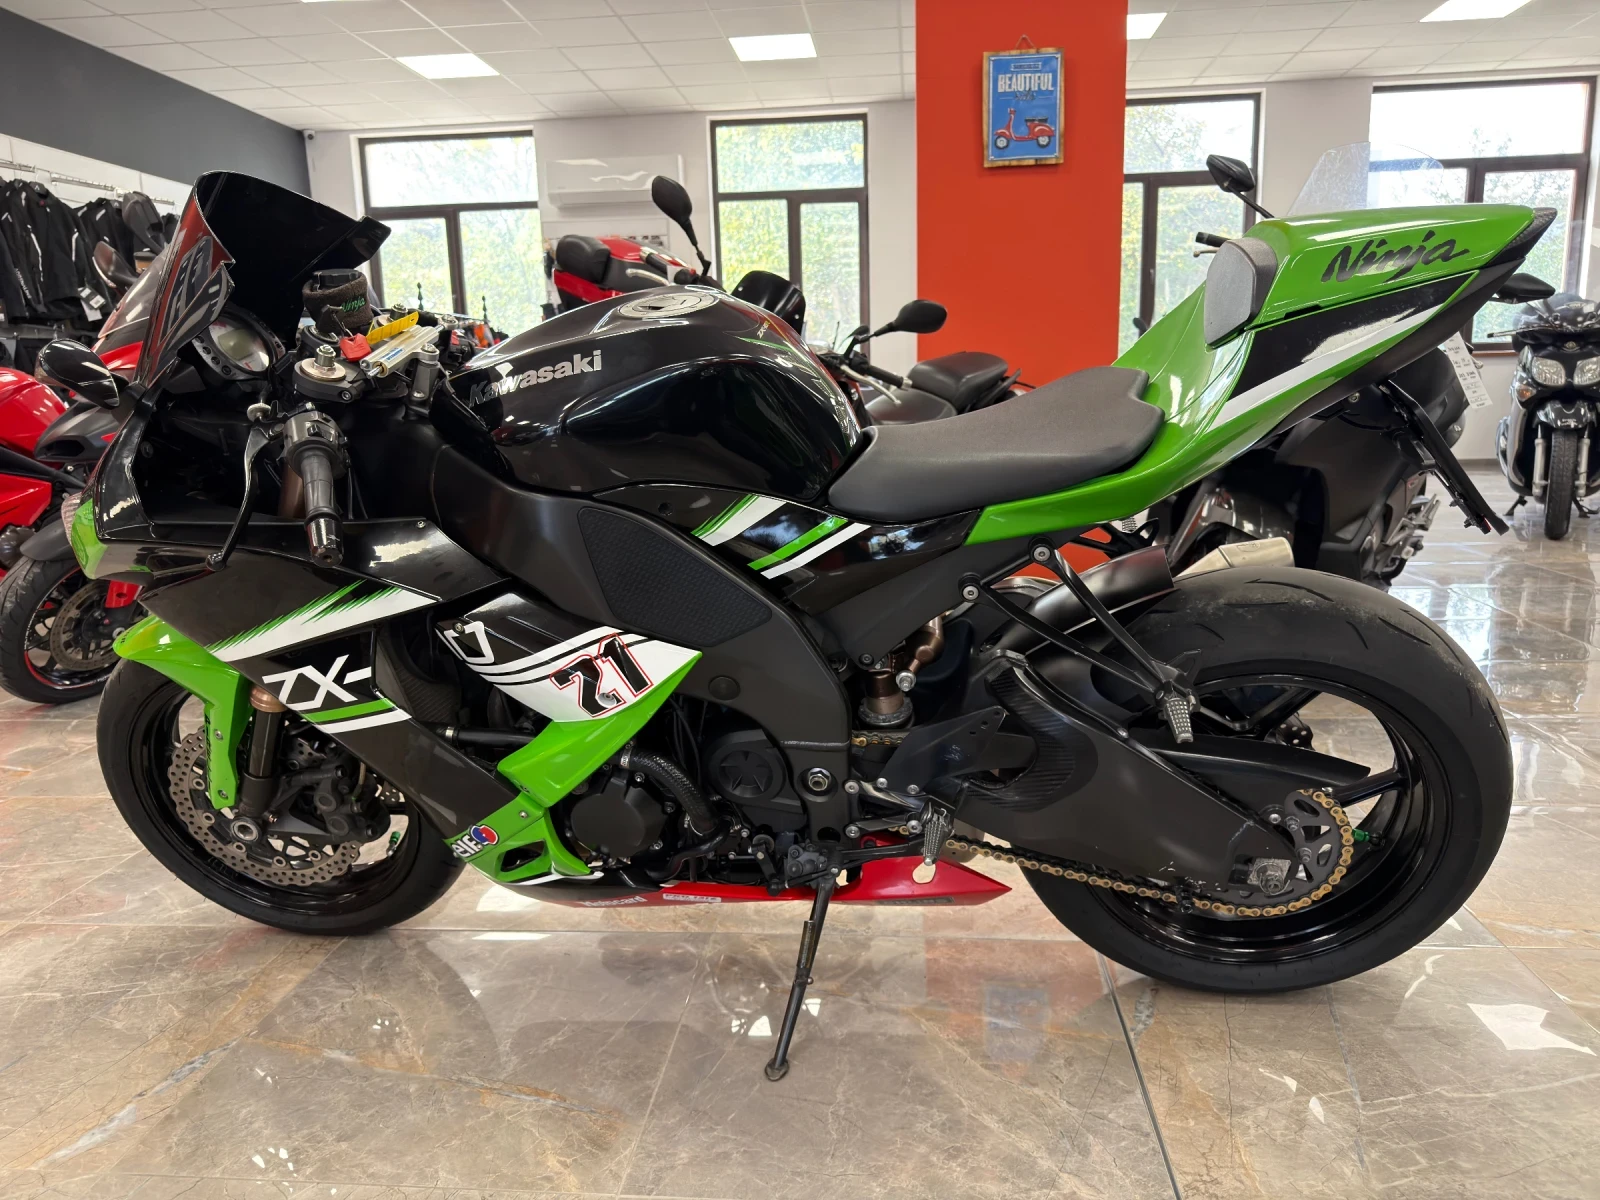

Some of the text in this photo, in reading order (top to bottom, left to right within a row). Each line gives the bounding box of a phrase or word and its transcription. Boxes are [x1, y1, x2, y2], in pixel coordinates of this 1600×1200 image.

[998, 73, 1054, 92] BEAUTIFUL
[1321, 230, 1470, 283] Ninja
[469, 350, 602, 407] Kawasaki
[550, 632, 654, 717] 21
